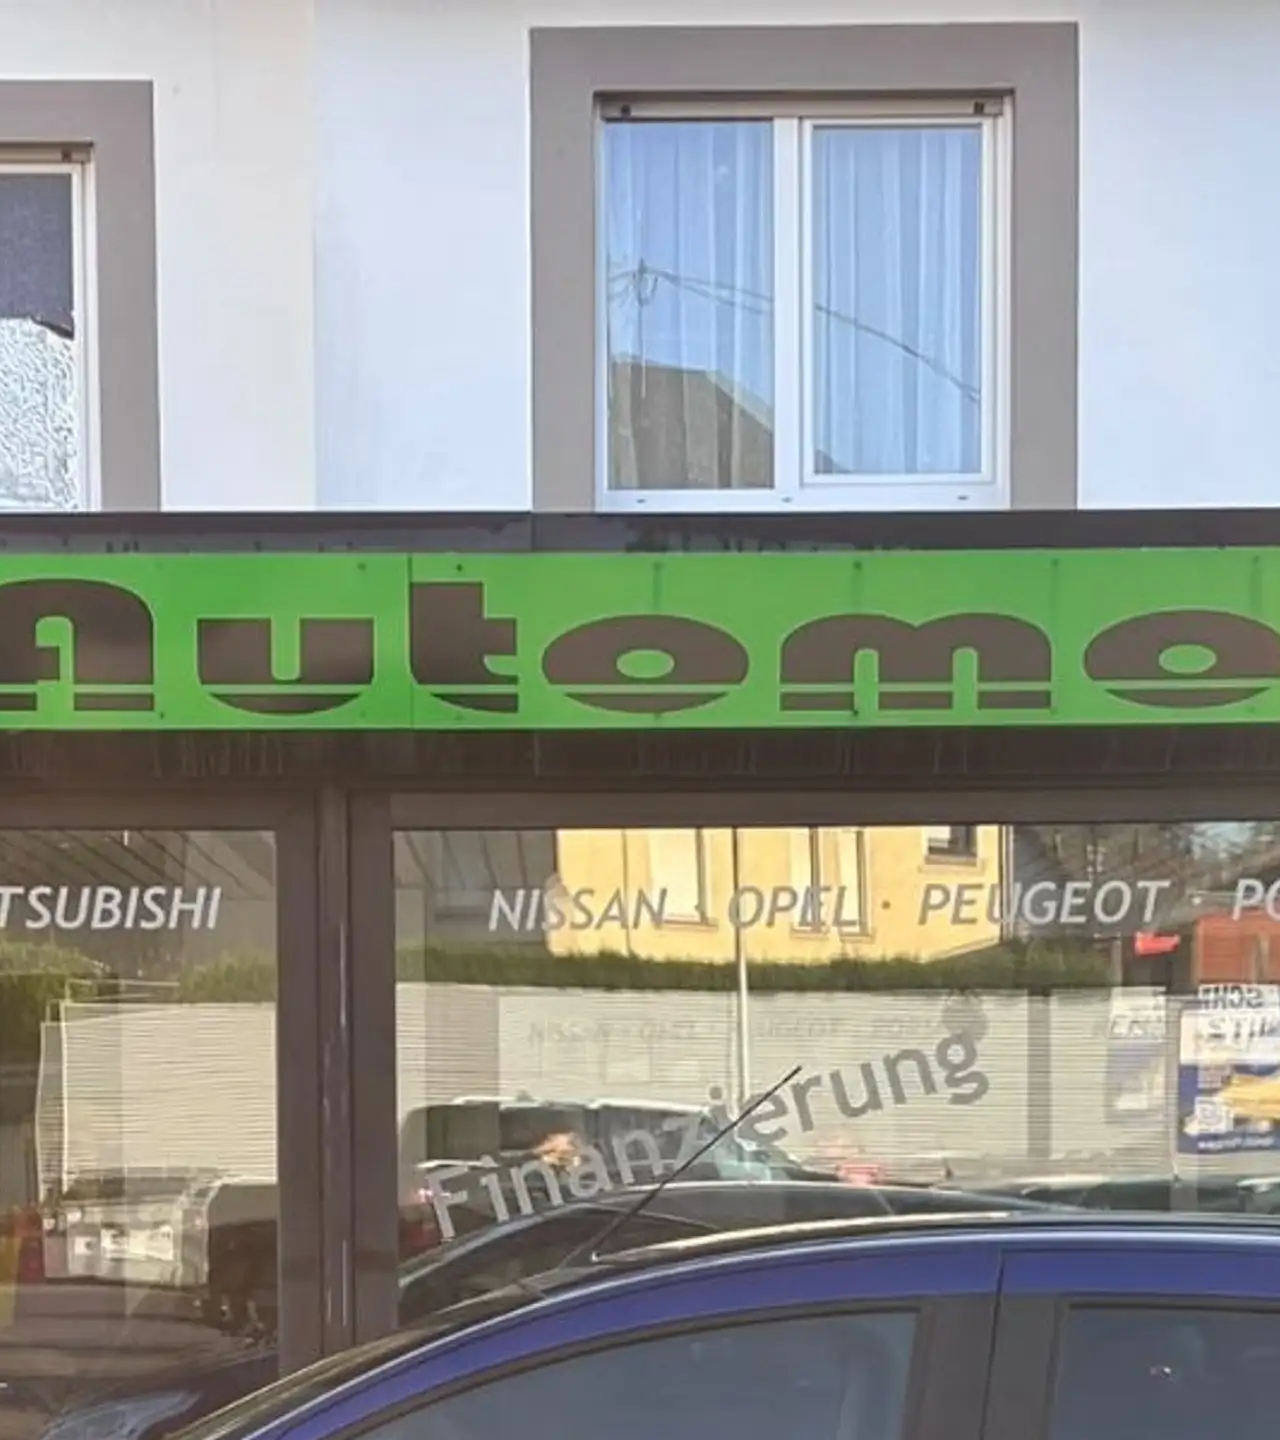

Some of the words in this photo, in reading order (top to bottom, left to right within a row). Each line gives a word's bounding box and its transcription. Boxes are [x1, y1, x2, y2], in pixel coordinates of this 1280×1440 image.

[488, 885, 668, 932] NISSAN
[728, 885, 861, 929] OPEL
[918, 879, 1171, 926] PEUGEOT
[422, 1030, 990, 1242] Finanzierung
